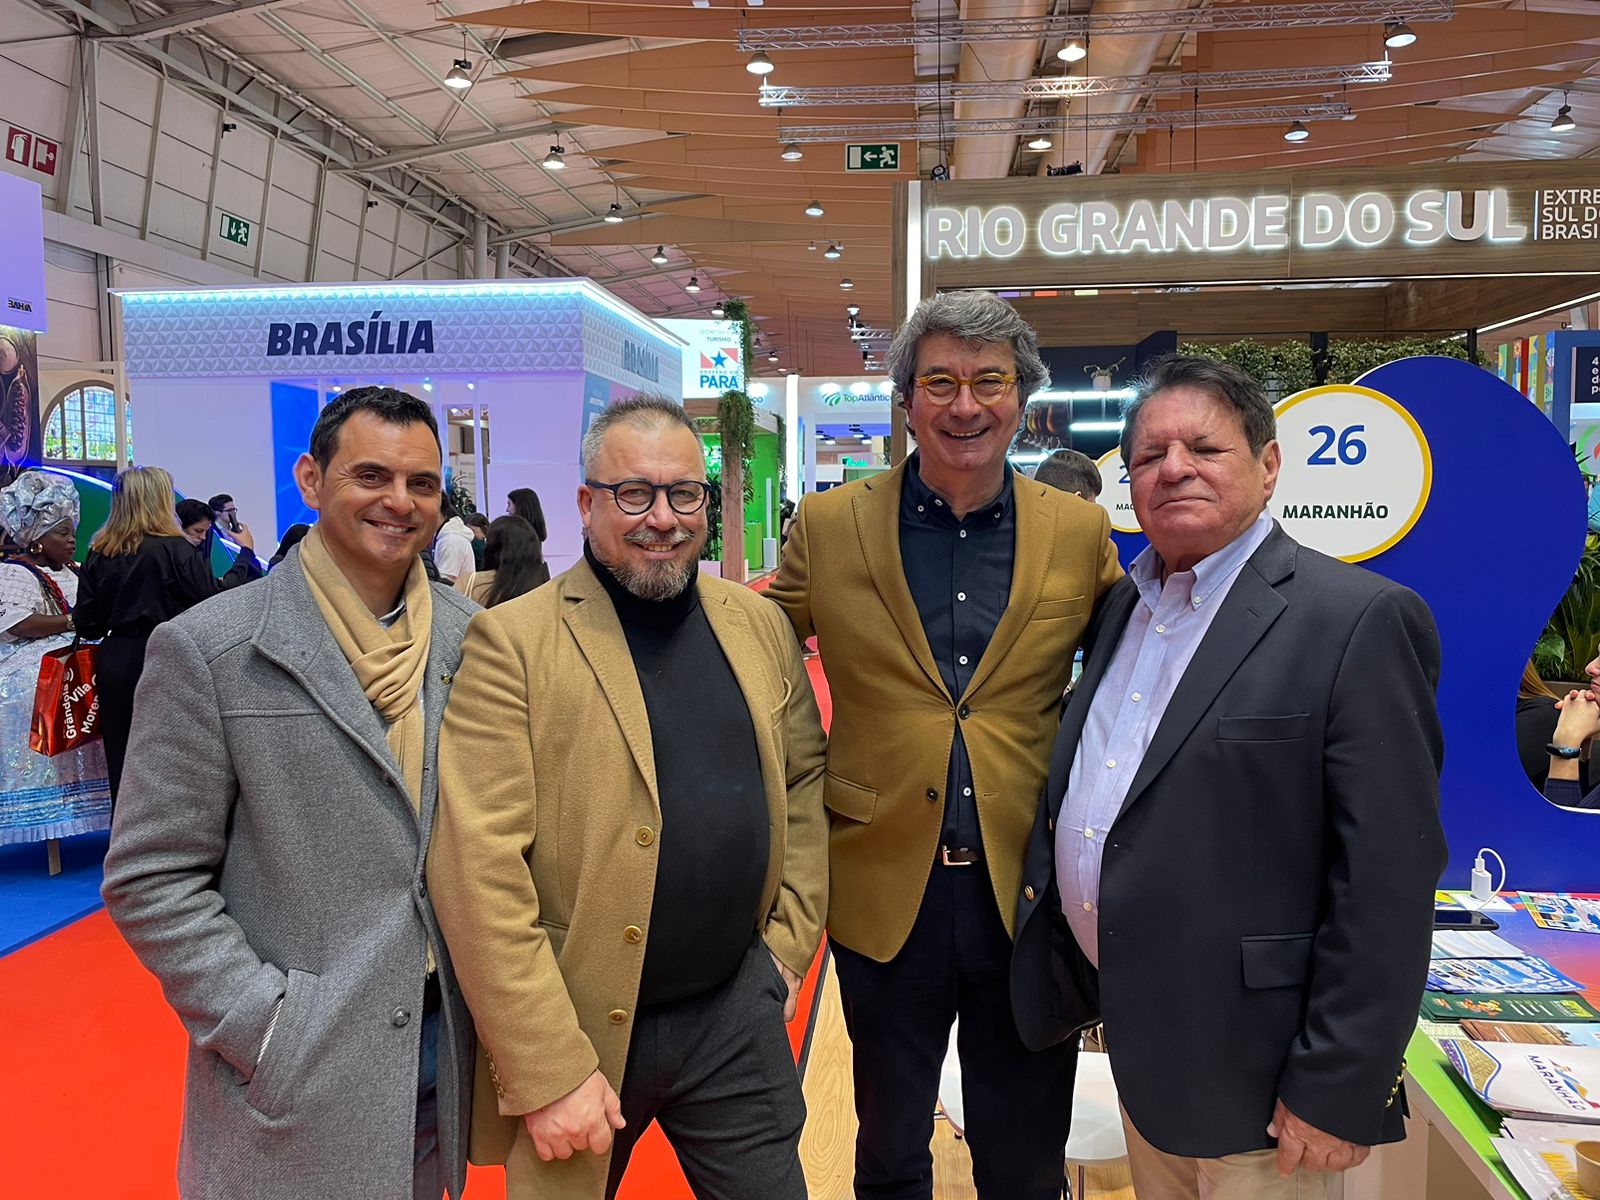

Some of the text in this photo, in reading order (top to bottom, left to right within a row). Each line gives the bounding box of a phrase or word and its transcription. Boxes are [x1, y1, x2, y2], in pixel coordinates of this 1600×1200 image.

[926, 187, 1528, 258] RIO GRANDE DO SUL
[1542, 206, 1600, 222] SUL D
[266, 311, 435, 356] BRASÍLIA
[1306, 424, 1368, 466] 26
[1282, 500, 1390, 520] MARANHÃO
[69, 683, 92, 703] Vila
[1527, 1054, 1587, 1111] MARANHÃO
